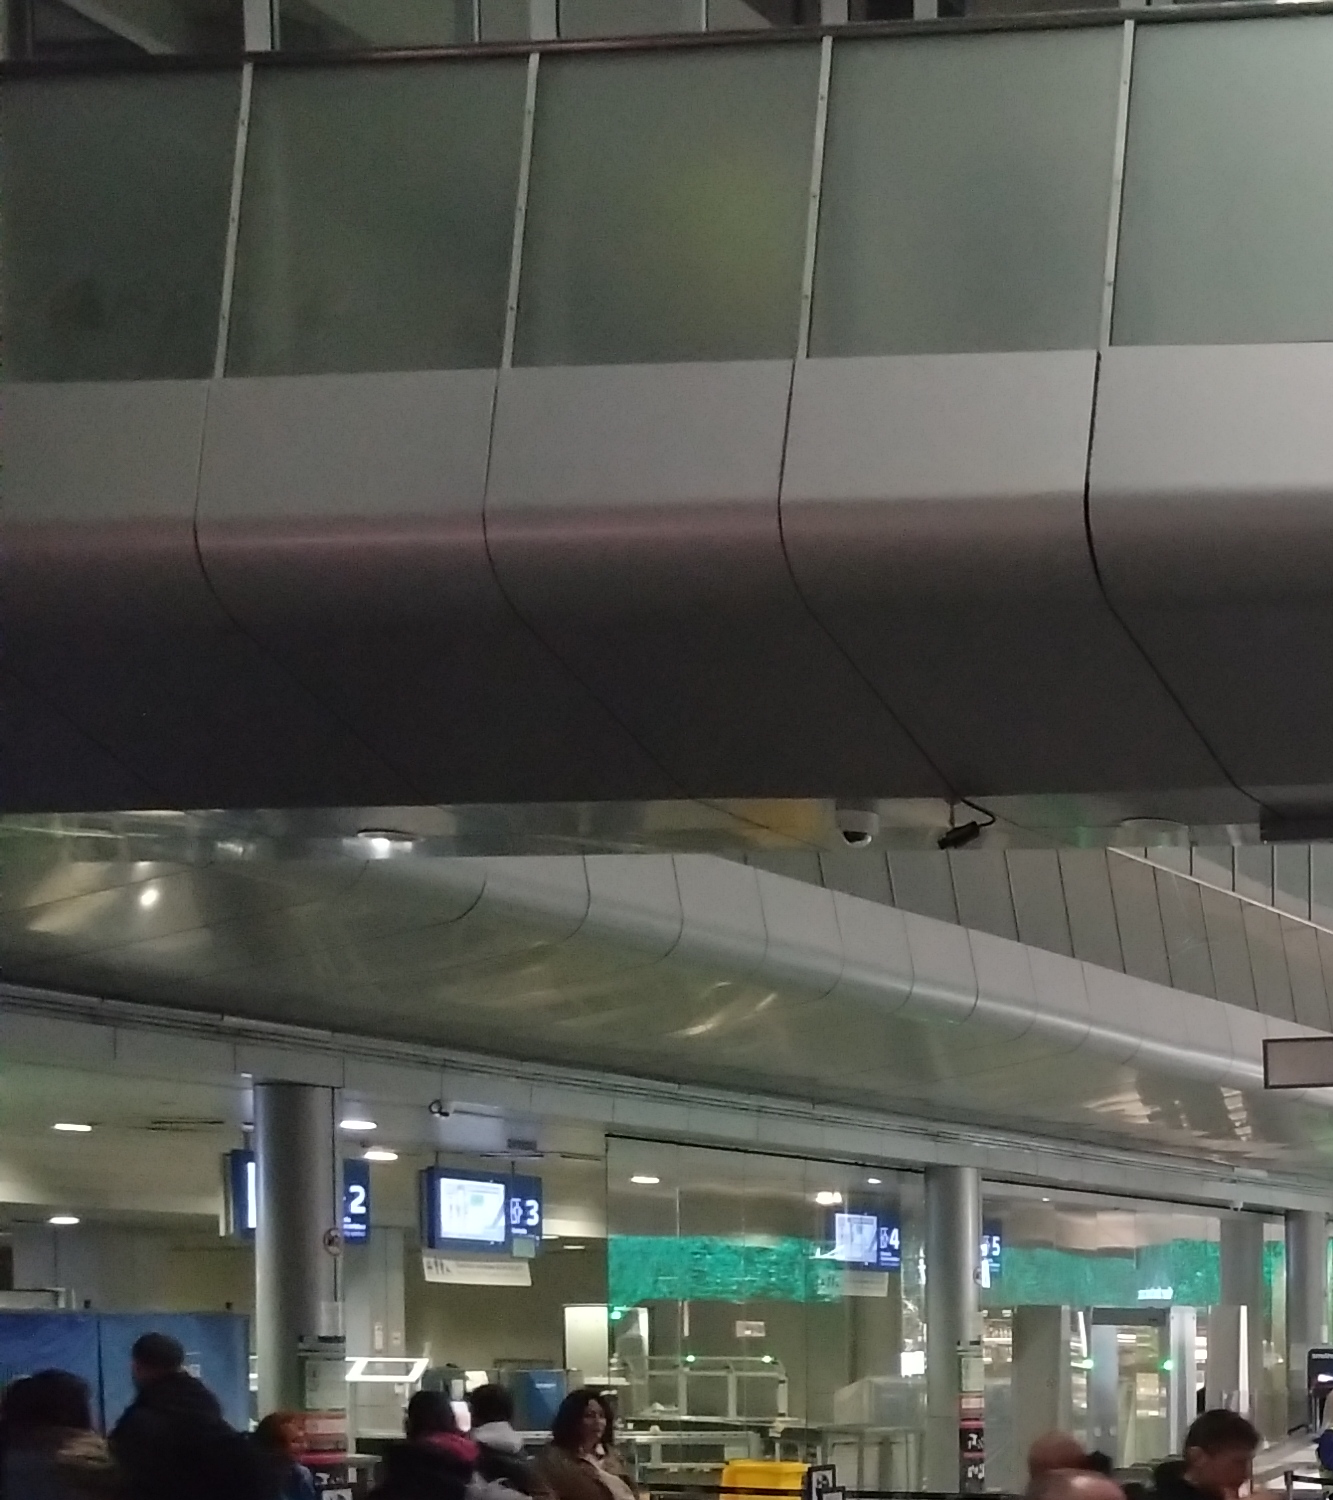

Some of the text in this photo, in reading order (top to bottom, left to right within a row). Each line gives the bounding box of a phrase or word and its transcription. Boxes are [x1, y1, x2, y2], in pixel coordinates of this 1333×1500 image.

[349, 1185, 366, 1214] 2
[525, 1199, 539, 1226] 3
[889, 1227, 900, 1250] 4
[992, 1236, 1001, 1257] 5
